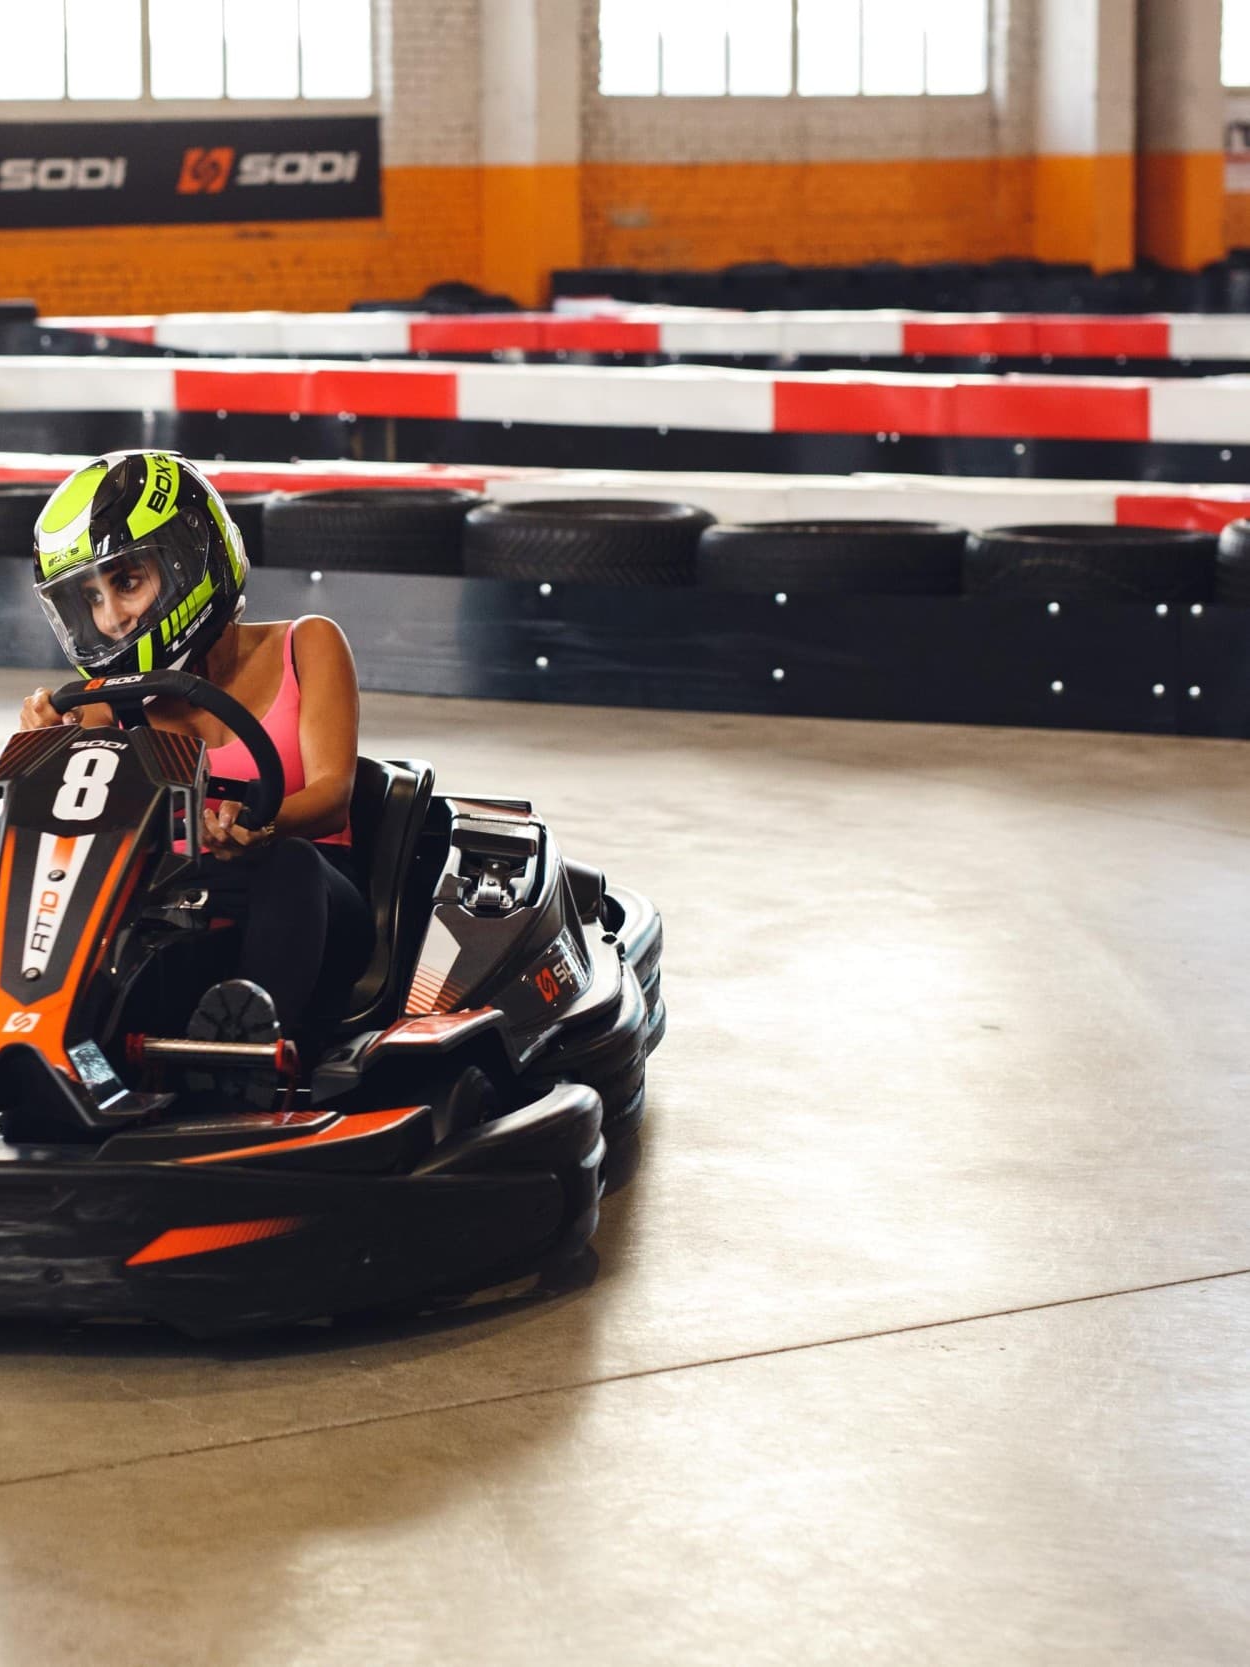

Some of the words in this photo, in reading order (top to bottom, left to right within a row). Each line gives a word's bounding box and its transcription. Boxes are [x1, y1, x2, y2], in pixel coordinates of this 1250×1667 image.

[237, 152, 359, 185] SODI
[172, 603, 213, 652] LS2
[103, 675, 144, 686] SODI
[70, 740, 129, 750] SODI
[52, 748, 120, 821] 8
[30, 890, 59, 953] RT10
